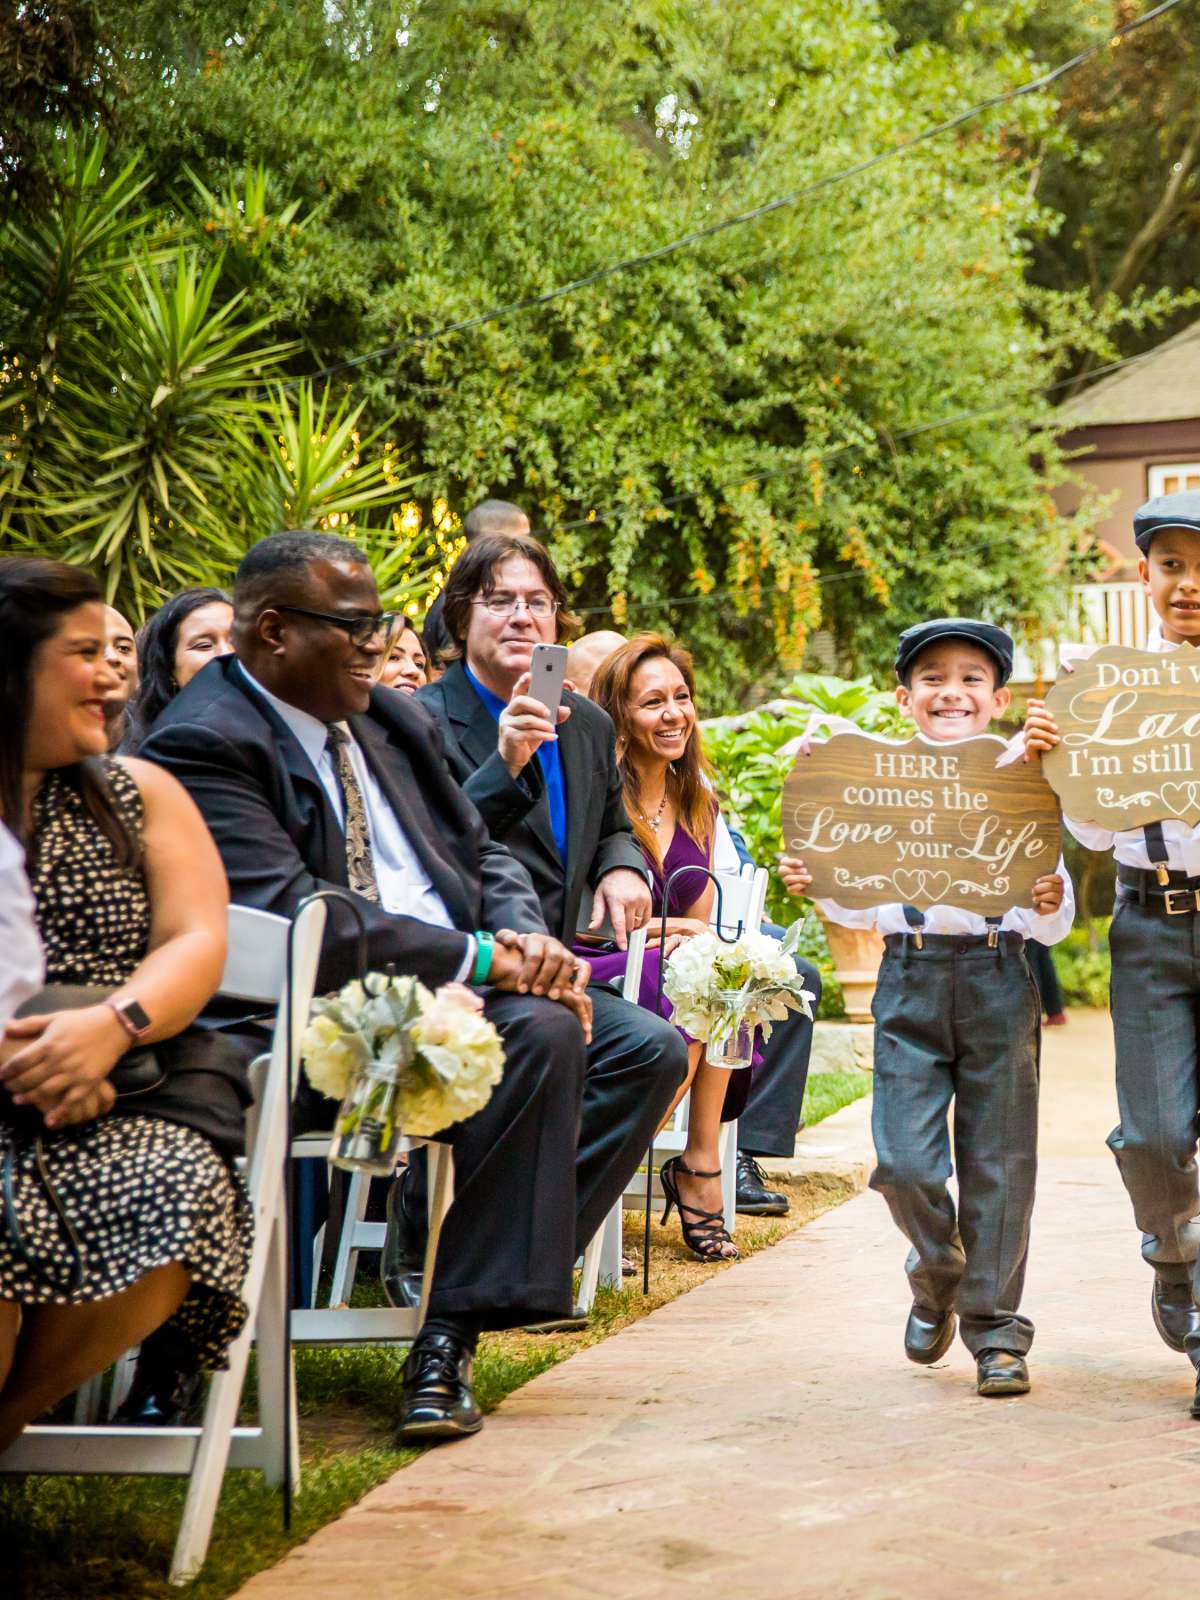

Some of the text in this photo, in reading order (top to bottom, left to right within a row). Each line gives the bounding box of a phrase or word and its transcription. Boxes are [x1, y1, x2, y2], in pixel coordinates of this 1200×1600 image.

[1096, 660, 1180, 689] Don't
[873, 753, 961, 780] HERE
[1068, 750, 1123, 777] I'm
[1132, 743, 1193, 774] still
[843, 783, 989, 811] comes the
[790, 802, 898, 852] Love
[911, 813, 936, 836] of
[896, 840, 953, 861] your
[954, 810, 1049, 875] Life
